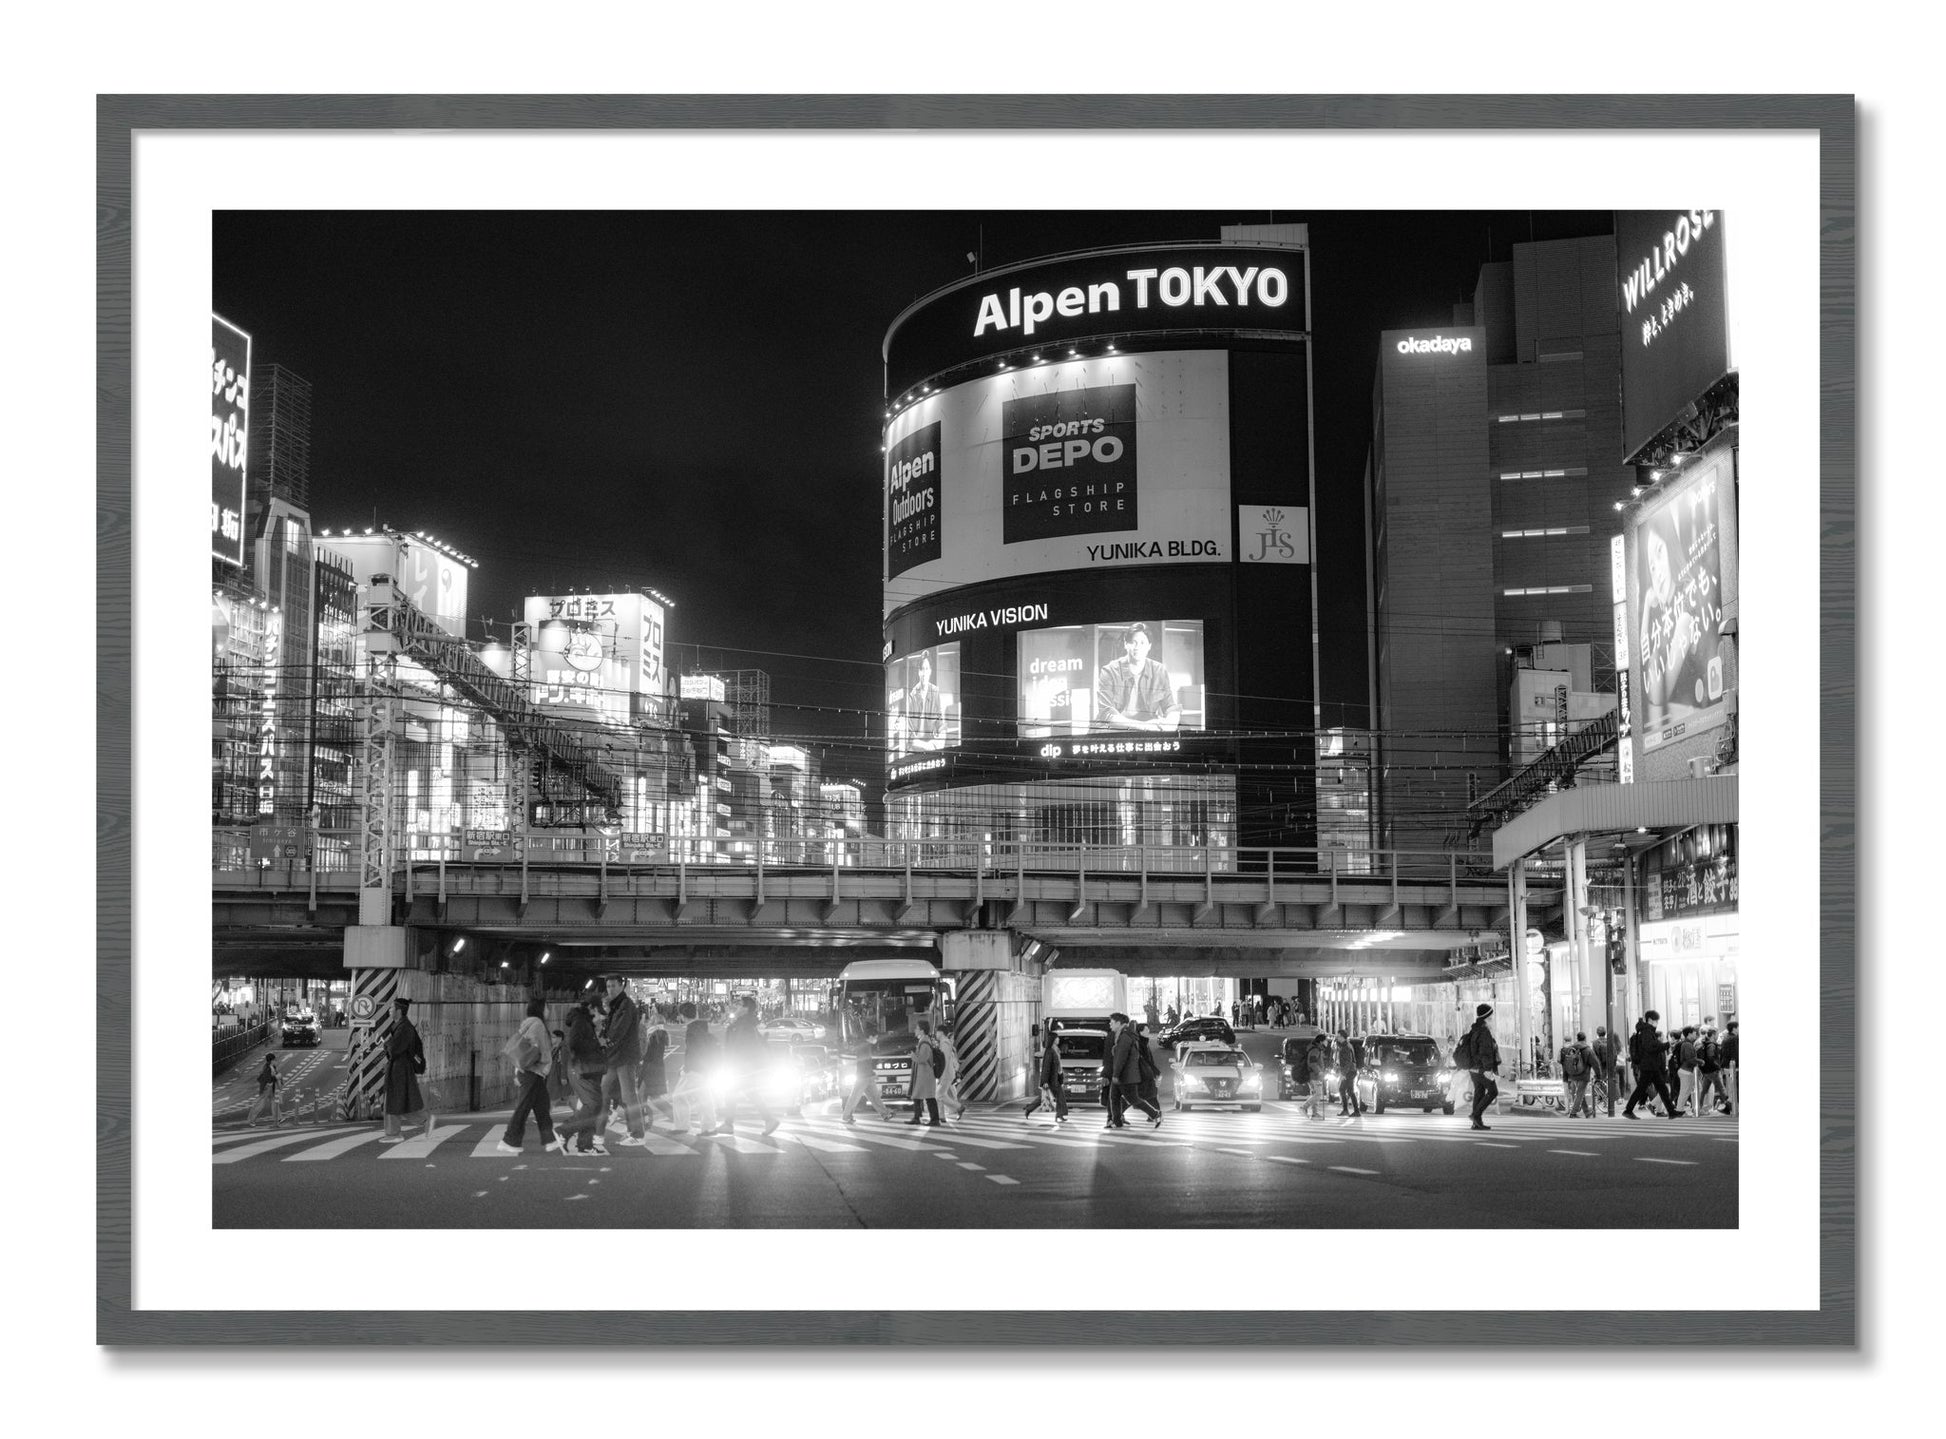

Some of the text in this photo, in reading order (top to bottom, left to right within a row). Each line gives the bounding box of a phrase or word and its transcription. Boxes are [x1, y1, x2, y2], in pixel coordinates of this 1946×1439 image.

[973, 266, 1288, 337] Alpen TOKYO
[1397, 335, 1472, 356] okadaya
[1029, 418, 1105, 441] SPORTS
[1013, 435, 1124, 474] DEPO
[890, 451, 935, 494] Alpen
[1013, 482, 1124, 505] FLAGSHIP
[893, 487, 934, 526] Outdoors
[1053, 499, 1124, 516] STORE
[890, 514, 935, 546] FLAGSHIP
[902, 530, 935, 552] STORE
[1087, 540, 1221, 561] YUNIKA BLDG.
[549, 598, 616, 618] プロミス
[936, 603, 1047, 636] YUNIKA VISION
[1030, 657, 1083, 674] dream
[1040, 743, 1062, 758] dip
